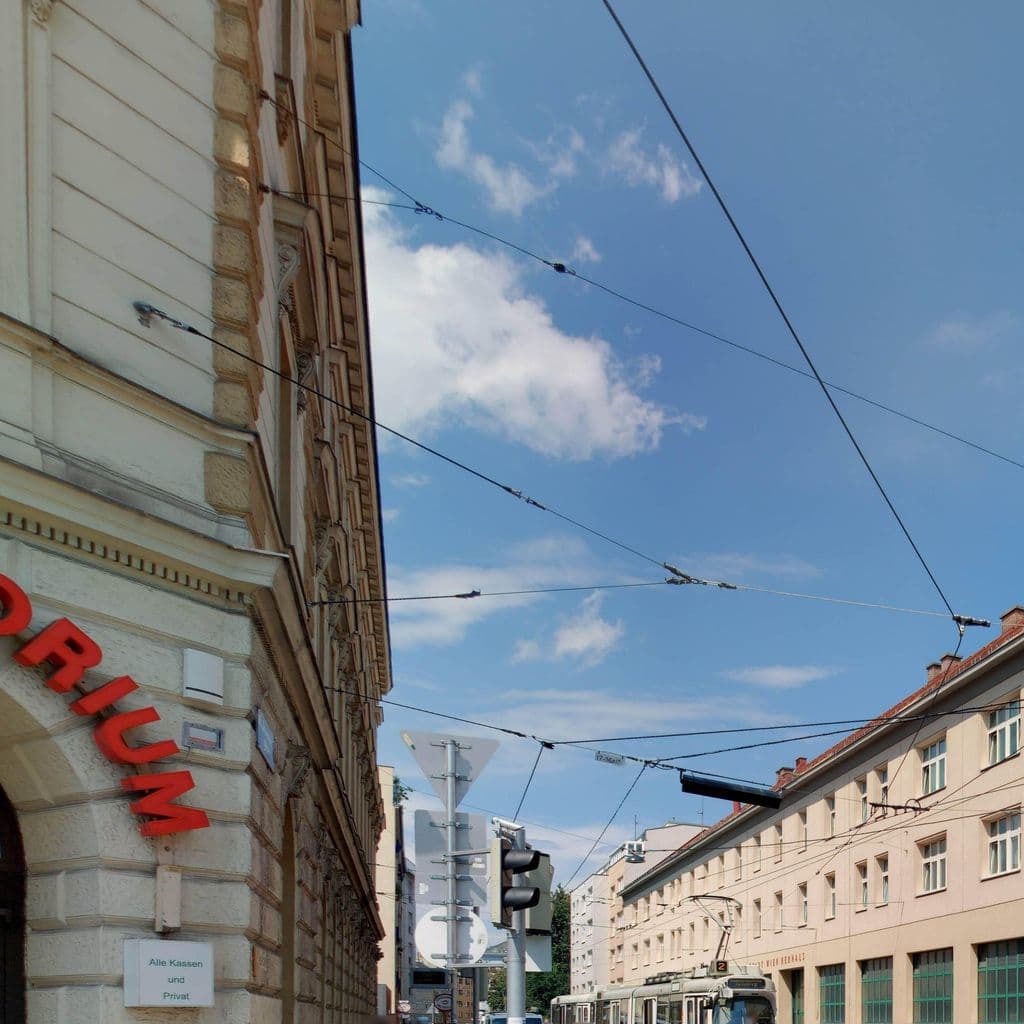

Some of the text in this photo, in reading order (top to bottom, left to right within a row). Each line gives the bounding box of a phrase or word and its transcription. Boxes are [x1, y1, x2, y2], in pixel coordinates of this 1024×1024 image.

[148, 958, 203, 968] Alle Kassen
[718, 962, 727, 970] 2
[167, 975, 185, 984] und
[163, 992, 190, 1000] Privat
